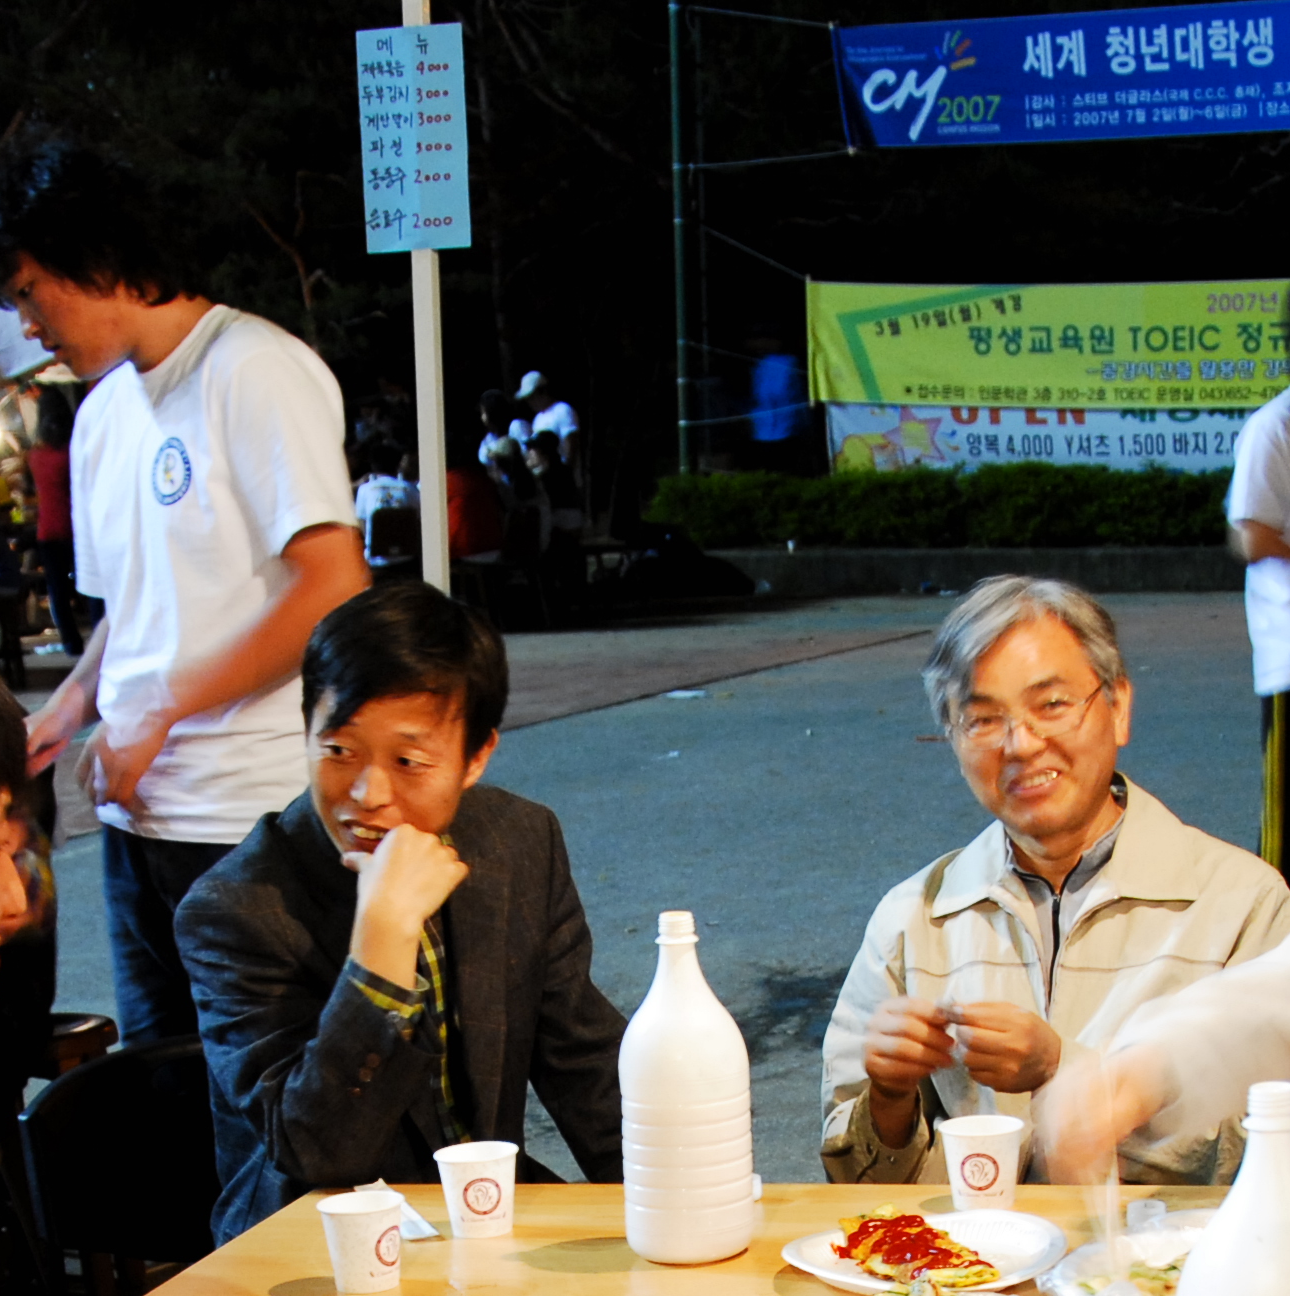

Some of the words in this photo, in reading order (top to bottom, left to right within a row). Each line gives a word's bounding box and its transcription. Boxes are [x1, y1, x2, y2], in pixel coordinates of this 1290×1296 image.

[1023, 29, 1087, 79] 세계
[1105, 16, 1275, 76] 청년대학생
[416, 60, 450, 76] 4000
[361, 84, 409, 106] 두부김치
[416, 87, 450, 104] 3000
[364, 112, 413, 131] 계란말이
[417, 111, 452, 127] 3000
[937, 94, 1002, 124] 2007
[1073, 109, 1120, 127] 2007년
[1125, 107, 1147, 124] 7월
[367, 166, 407, 196] 동동주
[413, 168, 452, 185] 2000
[365, 207, 408, 241] 음료수
[411, 212, 453, 229] 2000
[1207, 291, 1279, 314] 2007년
[874, 316, 902, 337] 3월
[912, 301, 982, 328] 19일(월)
[967, 323, 1116, 357] 평생교육원
[1127, 323, 1222, 353] TOEIC
[1198, 358, 1256, 381] 활용한
[917, 383, 966, 400] 접수문의
[1113, 386, 1151, 401] TOEIC
[966, 432, 1001, 458] 양복
[1064, 432, 1110, 458] Y셔츠
[1172, 431, 1207, 457] 바지
